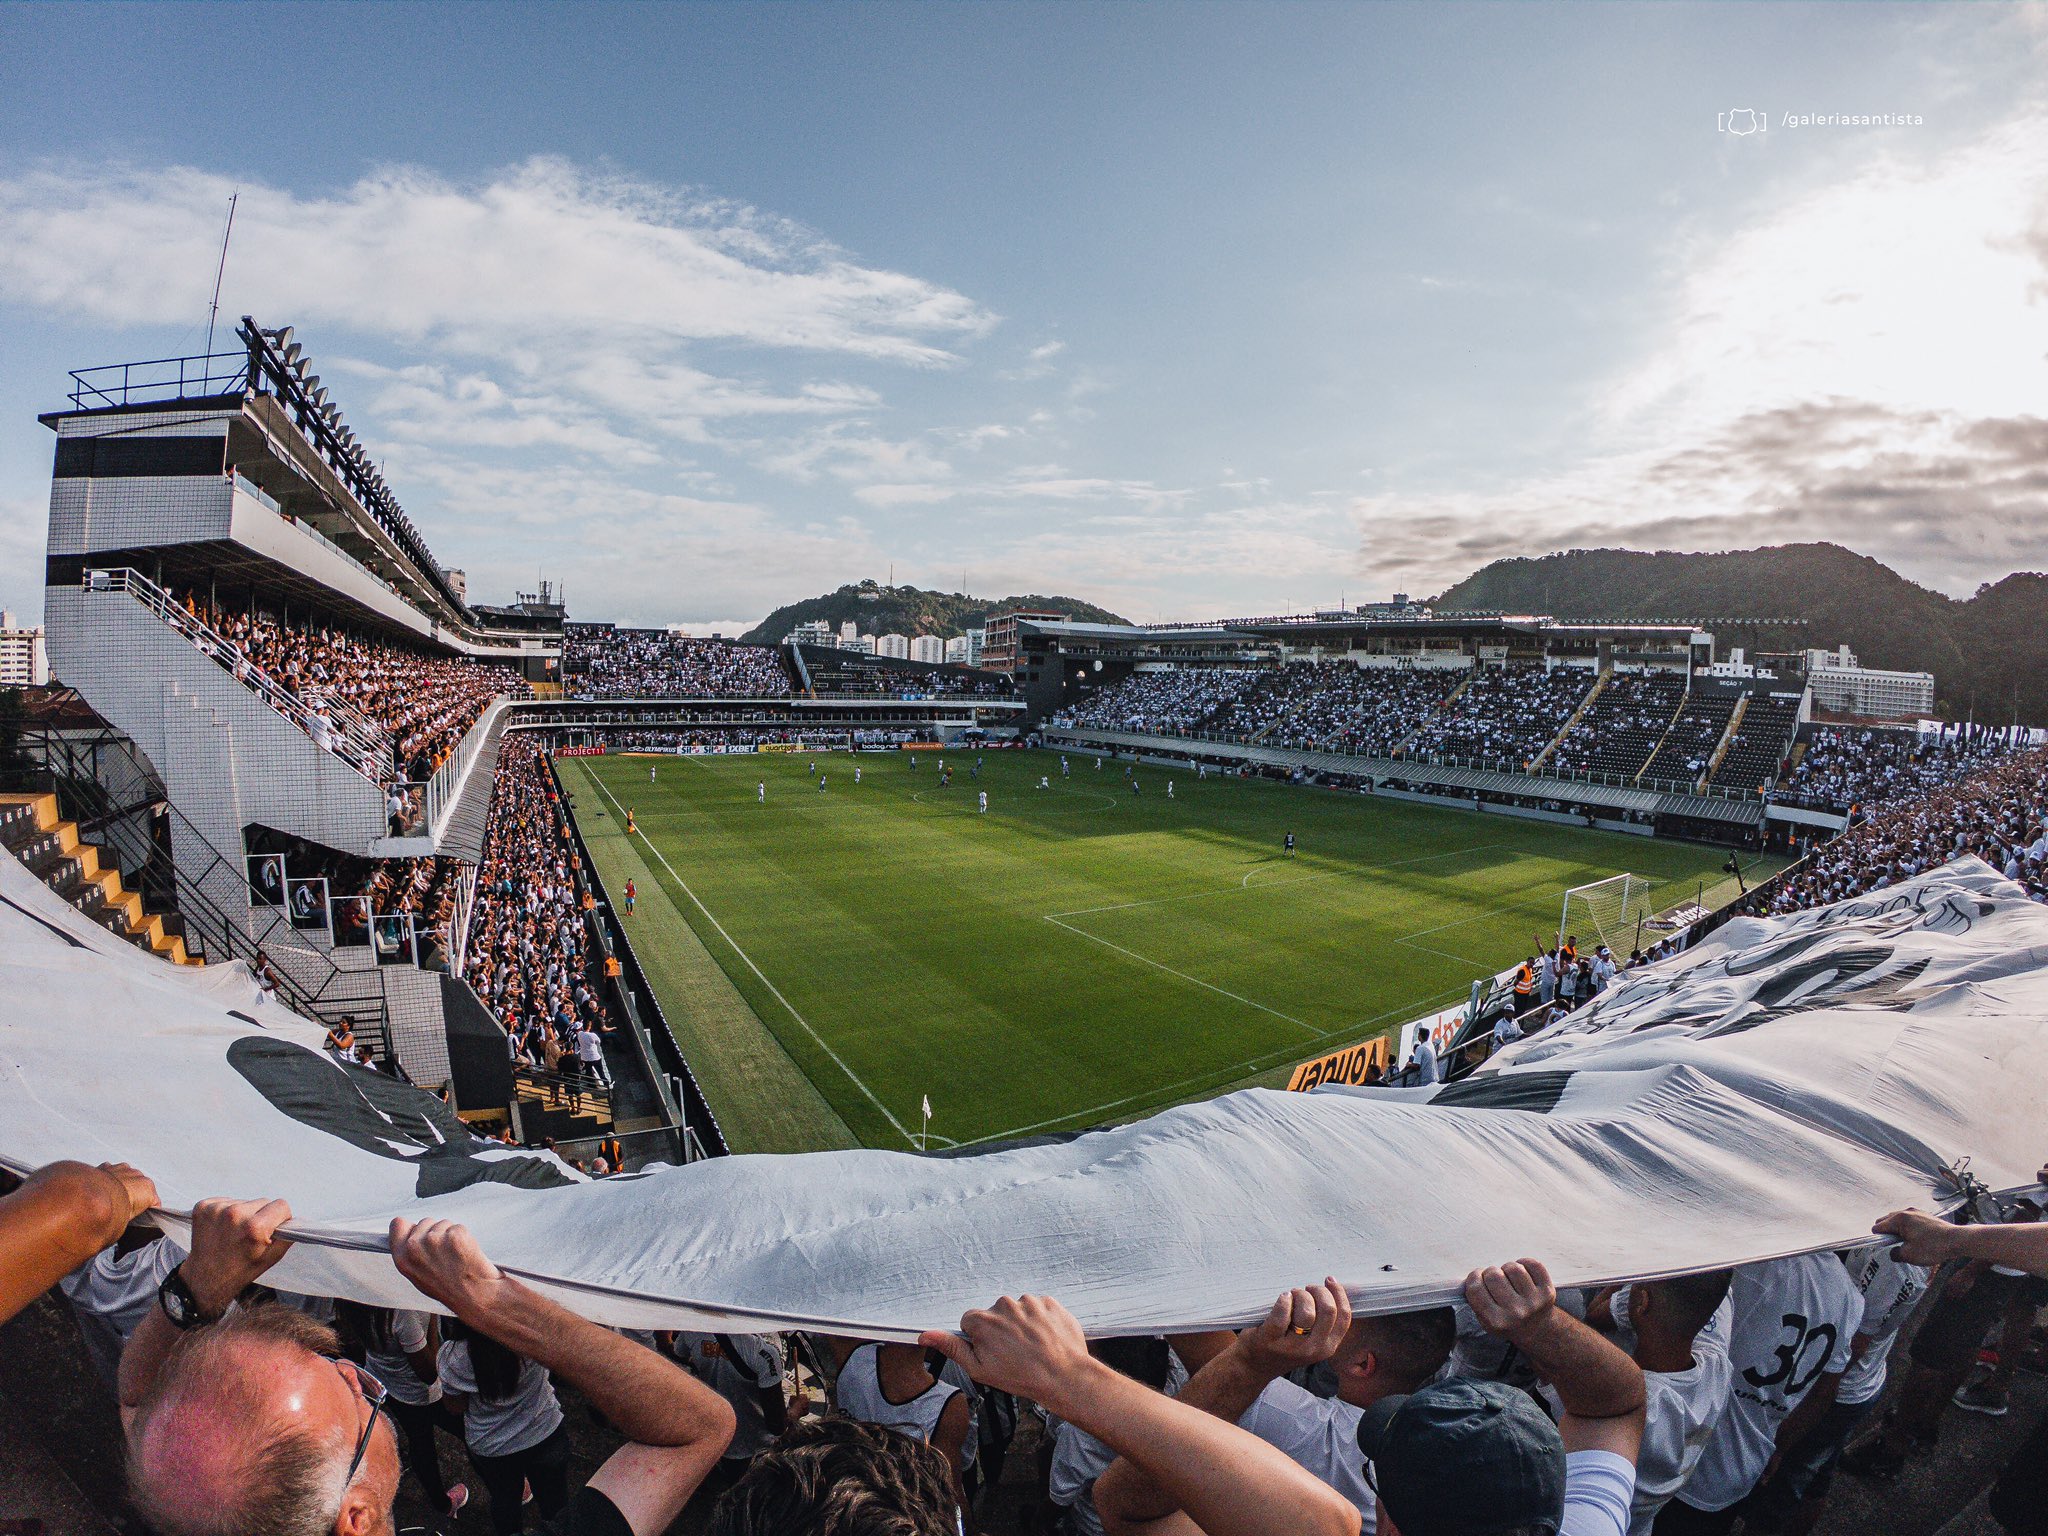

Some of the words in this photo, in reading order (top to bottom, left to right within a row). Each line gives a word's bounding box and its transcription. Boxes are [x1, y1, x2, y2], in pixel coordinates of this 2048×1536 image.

[728, 744, 756, 753] 1XBET
[861, 743, 899, 751] bodog.net
[1741, 1313, 1837, 1397] 30
